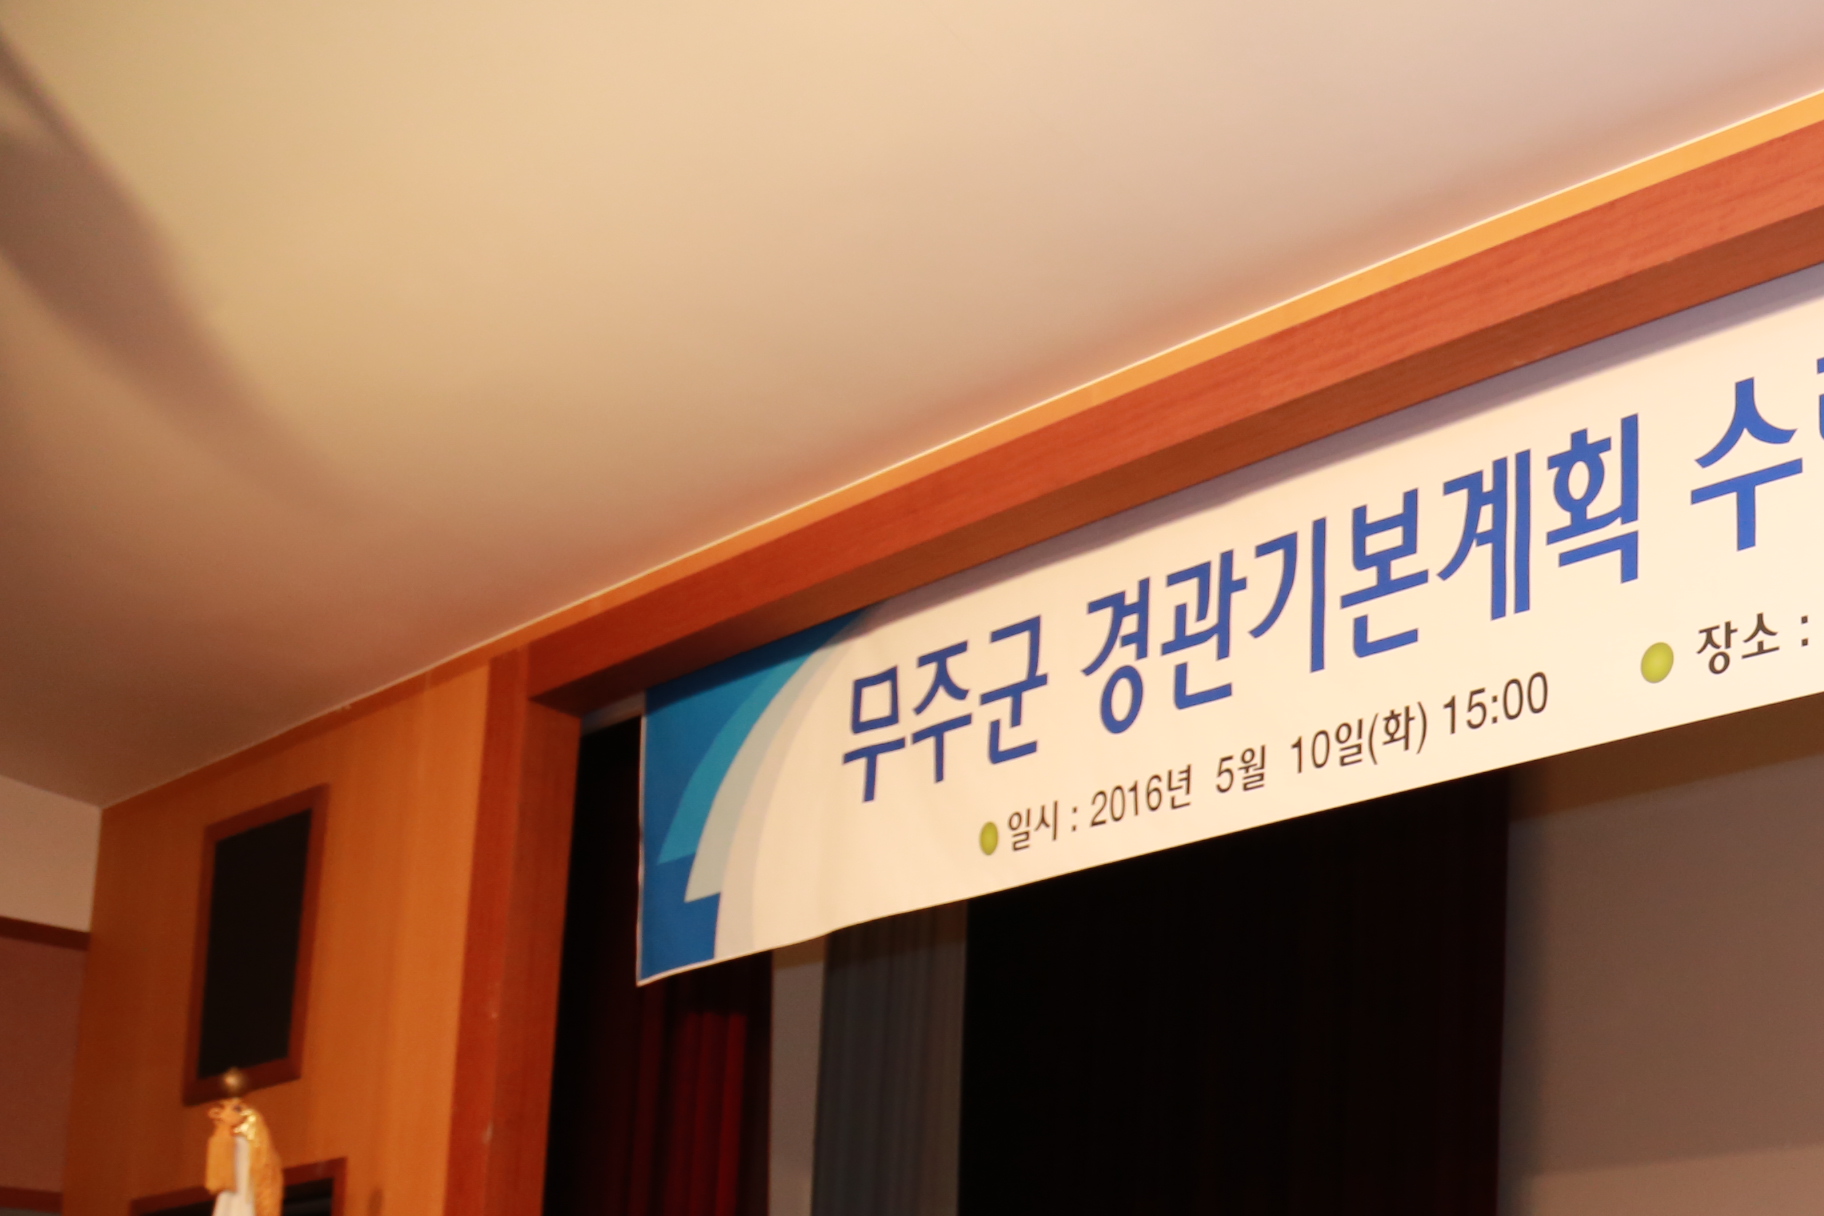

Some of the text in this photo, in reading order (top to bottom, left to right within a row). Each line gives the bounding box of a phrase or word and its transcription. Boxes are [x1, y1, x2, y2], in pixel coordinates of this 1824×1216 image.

[842, 615, 1048, 802] 무주군
[1081, 413, 1639, 735] 경관기본계획
[1697, 613, 1780, 674] 장소
[1008, 801, 1058, 851] 일시
[1090, 764, 1191, 827] 2016년
[1216, 745, 1265, 793] 5월
[1291, 702, 1427, 773] 10일(화)
[1443, 672, 1548, 734] 15:00
